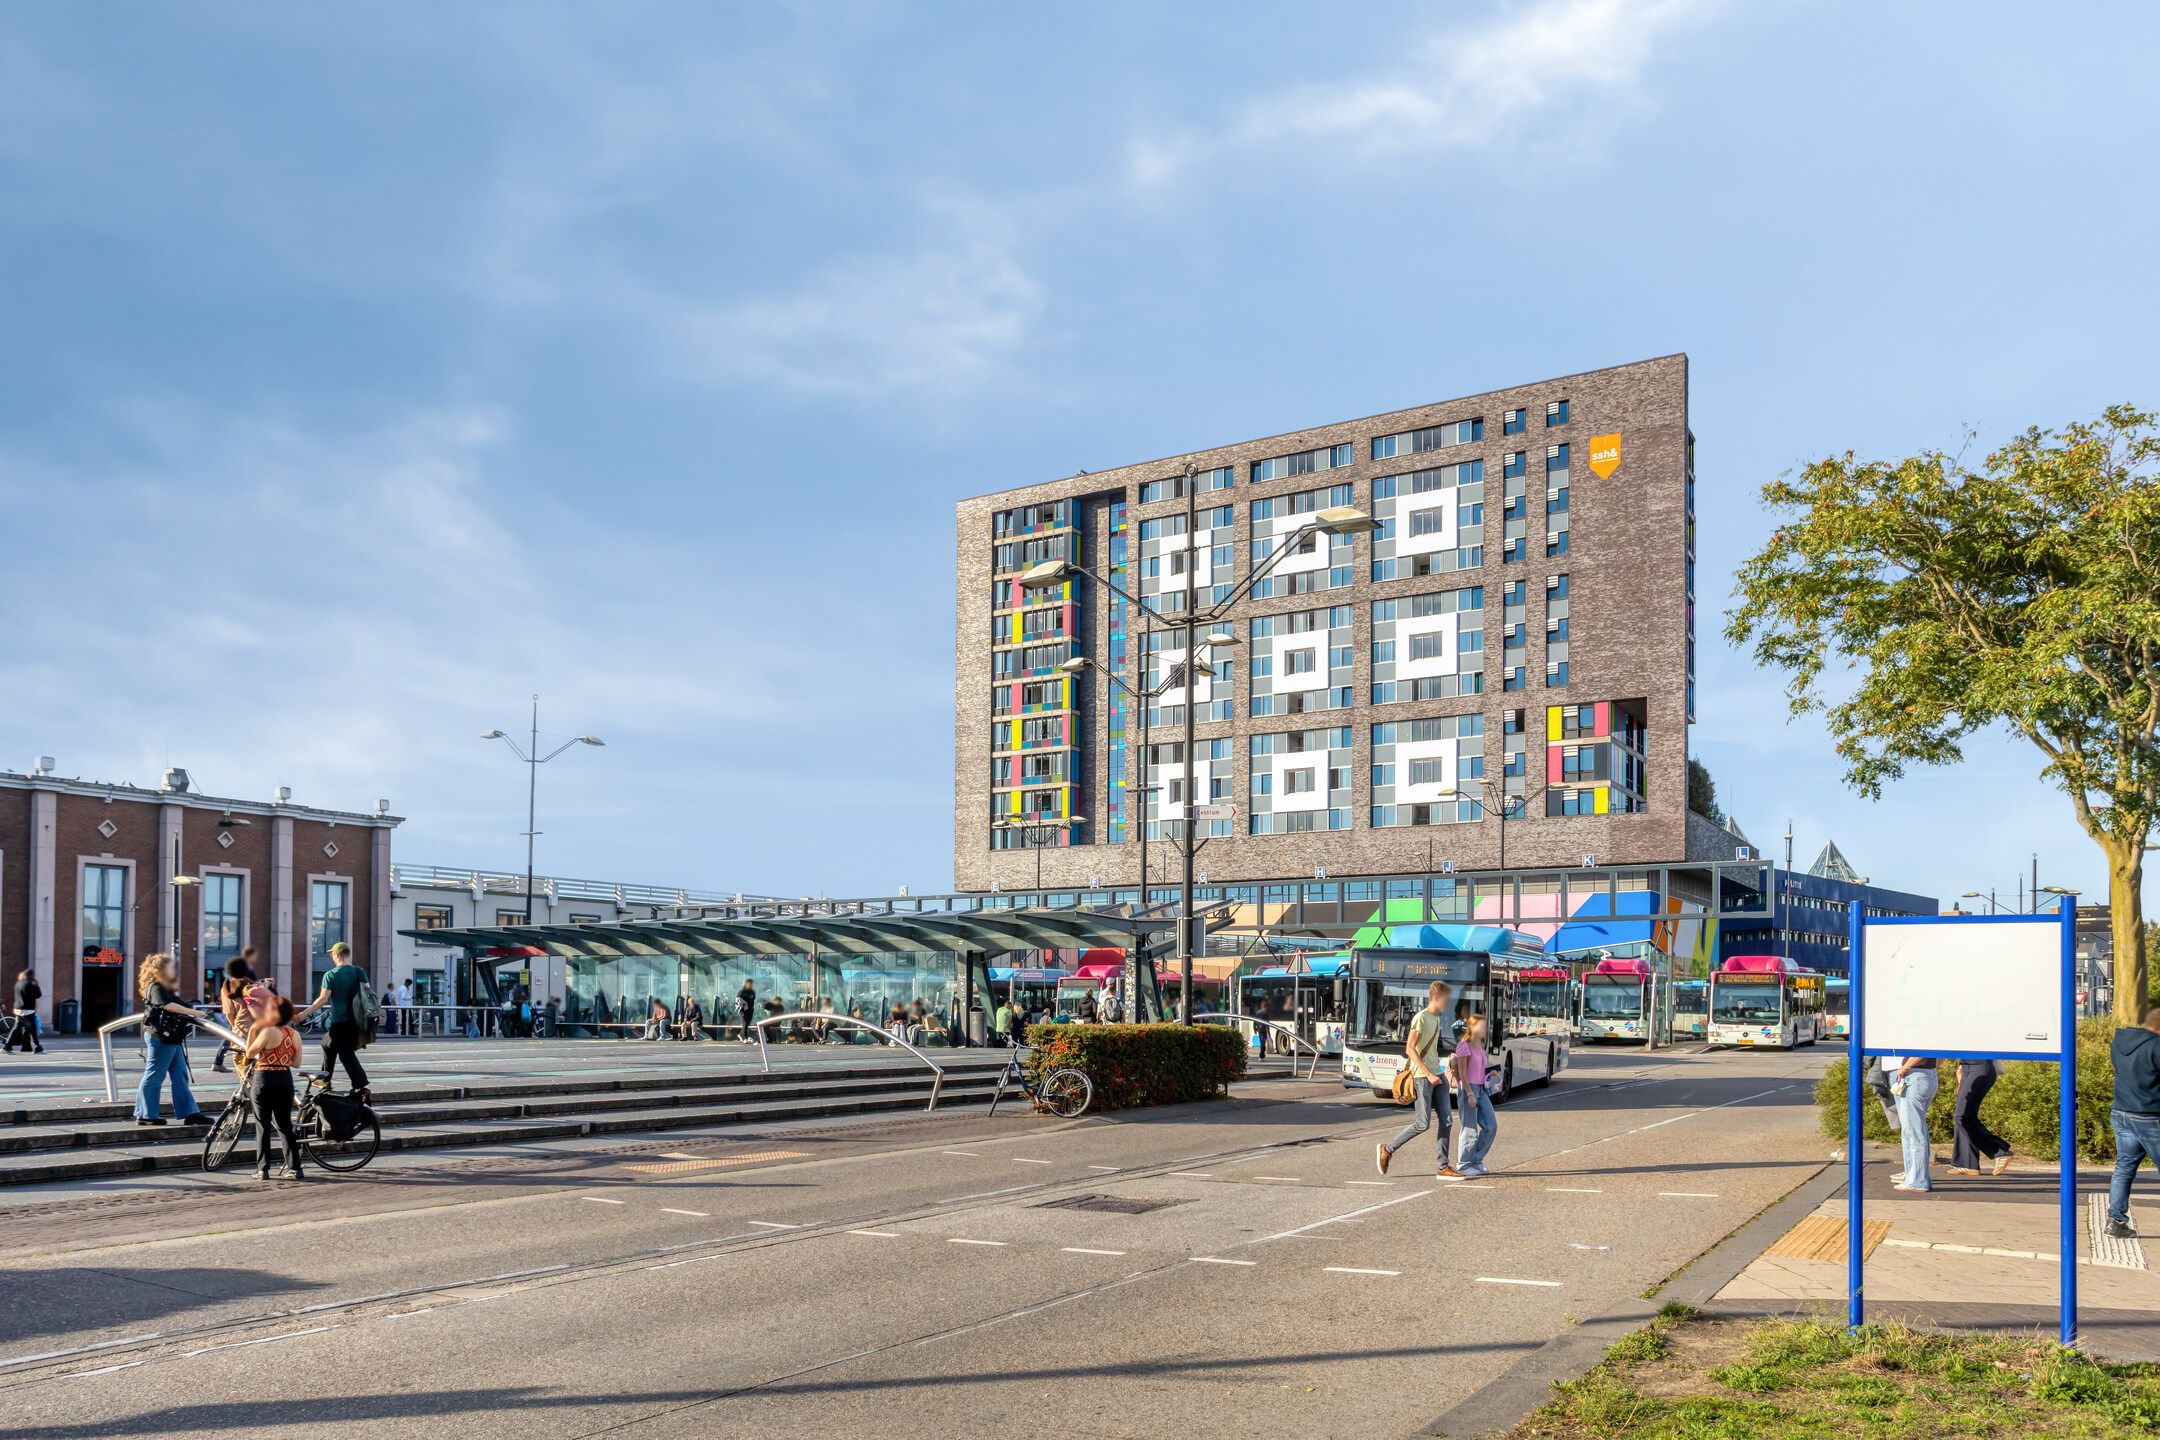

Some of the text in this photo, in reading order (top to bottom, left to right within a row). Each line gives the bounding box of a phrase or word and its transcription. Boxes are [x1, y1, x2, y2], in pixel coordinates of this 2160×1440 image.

[1592, 448, 1618, 460] ssh&
[1784, 880, 1802, 889] PLITIE
[1376, 1055, 1398, 1066] breng
